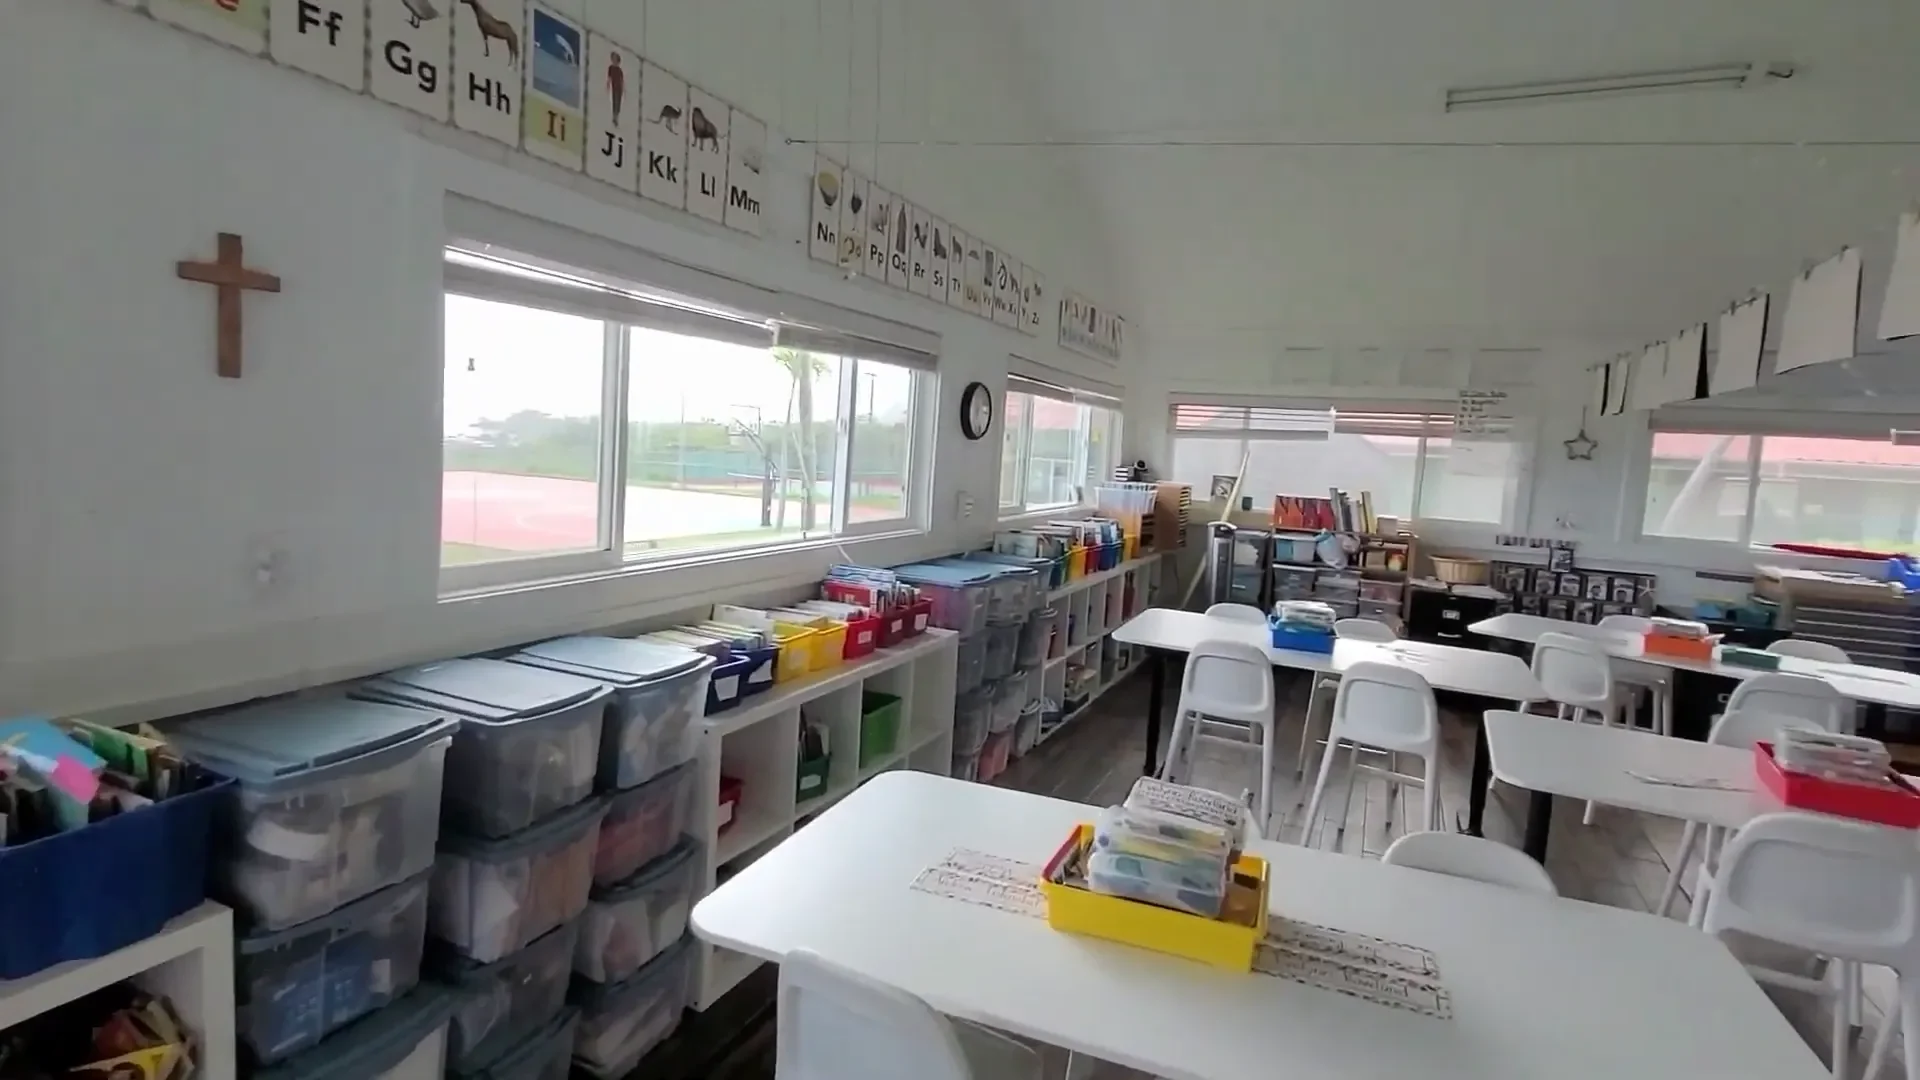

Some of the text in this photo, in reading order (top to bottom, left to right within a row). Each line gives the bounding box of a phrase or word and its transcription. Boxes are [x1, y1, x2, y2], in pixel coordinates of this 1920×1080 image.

[298, 0, 343, 46] Ff
[384, 40, 437, 93] Gg
[469, 72, 511, 115] Hh
[547, 110, 566, 142] Ii
[601, 131, 624, 168] Jj
[649, 151, 677, 183] Kk
[701, 172, 715, 197] Ll
[730, 186, 760, 215] Mm
[817, 221, 836, 244] Nn
[870, 244, 884, 267] Pp
[892, 254, 906, 277] Qq
[914, 262, 925, 278] Rr
[933, 270, 943, 287] Ss
